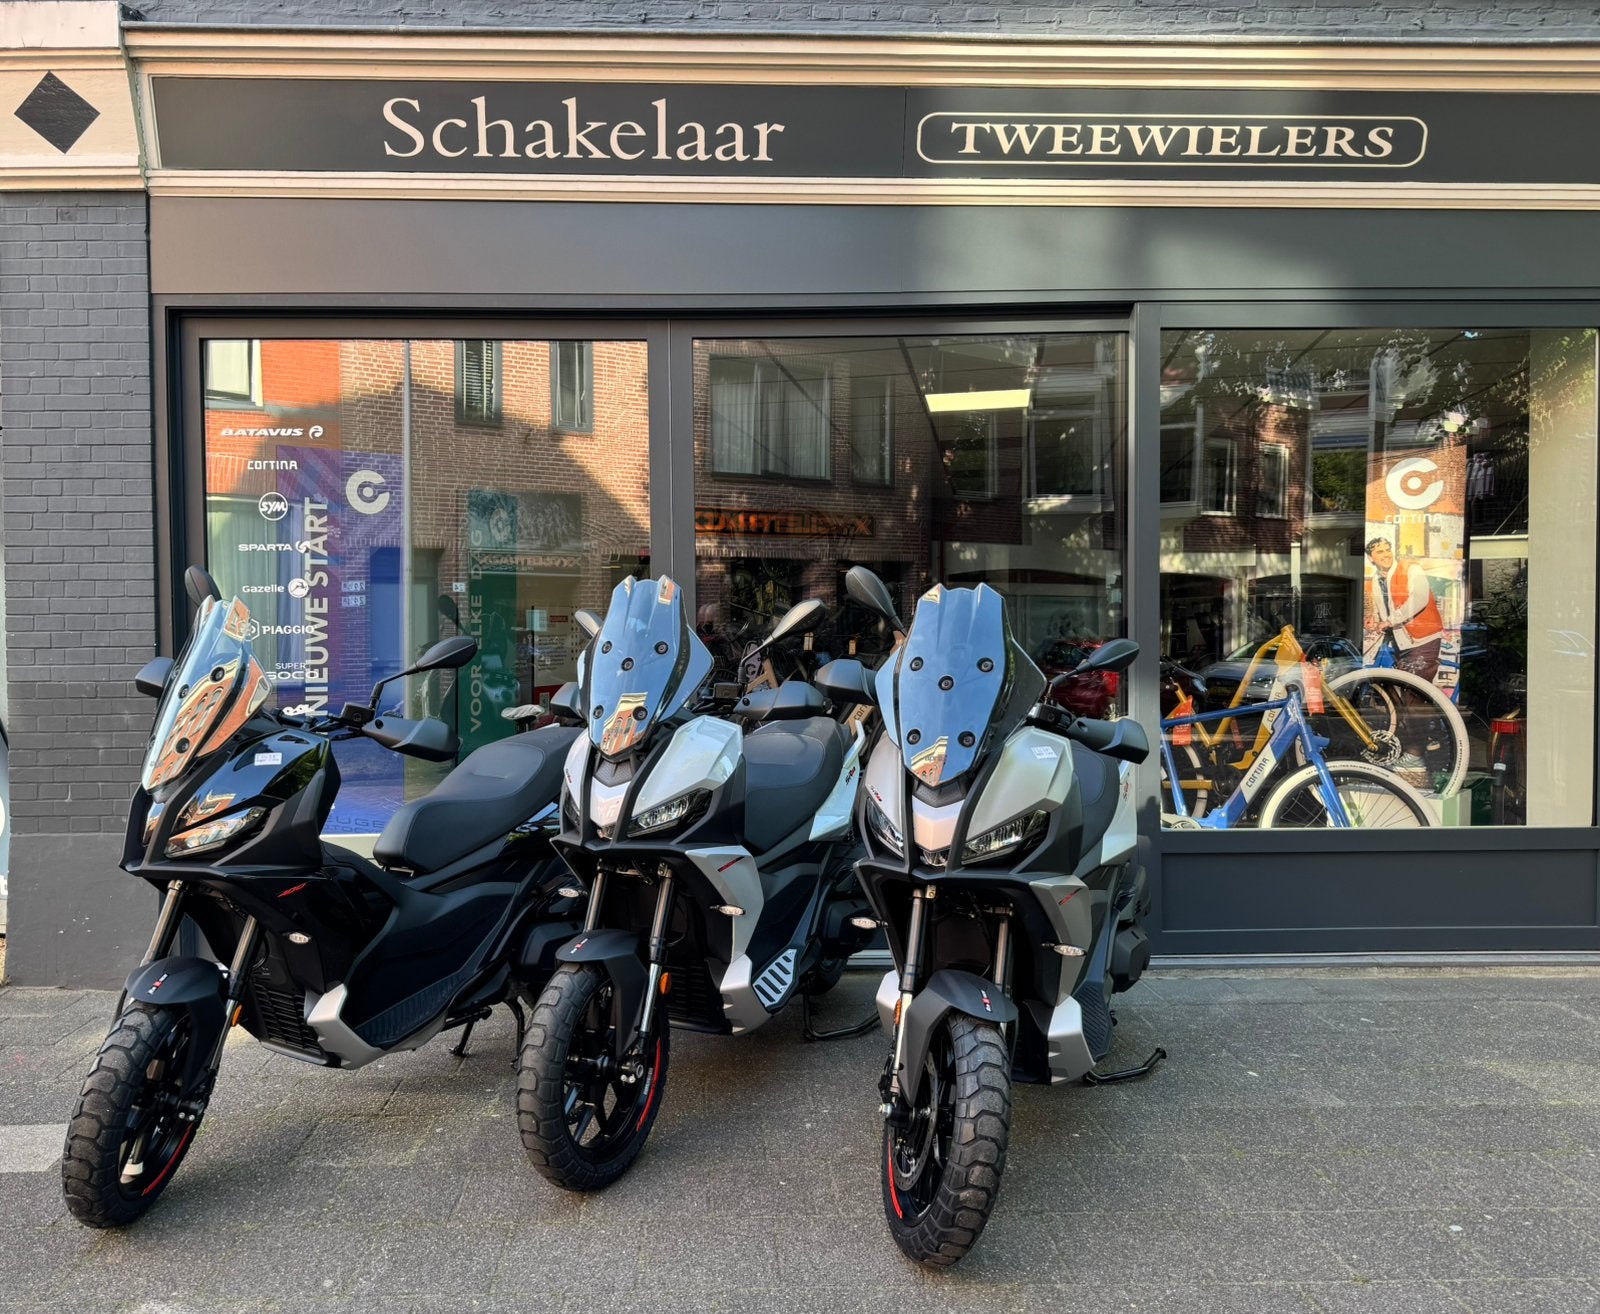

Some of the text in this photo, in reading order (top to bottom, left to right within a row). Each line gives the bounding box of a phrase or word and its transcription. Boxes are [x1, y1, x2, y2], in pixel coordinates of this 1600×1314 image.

[382, 95, 786, 162] Schakelaar
[950, 121, 1394, 158] TWEEWIELERS
[220, 427, 304, 436] BATAVUS
[259, 501, 287, 515] SYM
[238, 543, 292, 552] SPARTA
[242, 584, 285, 593] Gazelle
[304, 497, 329, 717] NIEUWE START
[470, 594, 482, 650] ELKE
[262, 625, 315, 635] PIAGGIO
[275, 662, 306, 670] SUPER
[470, 664, 482, 733] VOOR
